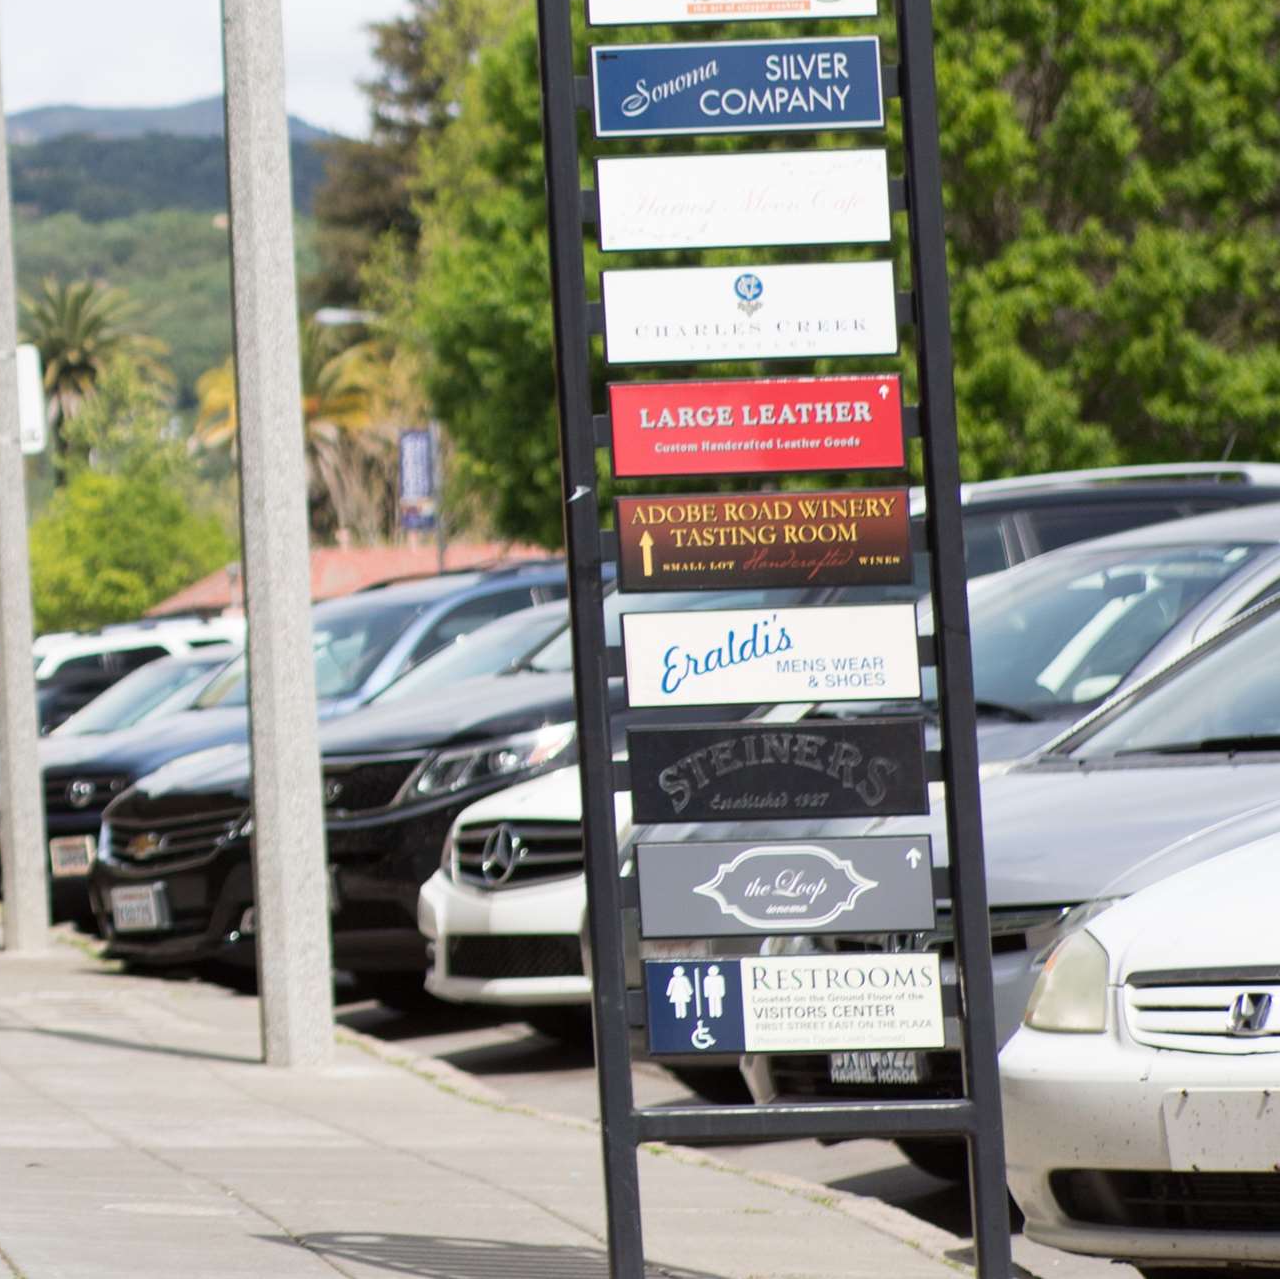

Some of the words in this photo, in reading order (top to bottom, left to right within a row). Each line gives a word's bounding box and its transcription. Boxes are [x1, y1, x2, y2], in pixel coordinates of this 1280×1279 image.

[765, 52, 849, 82] SILVER
[621, 59, 719, 118] Sonoma
[699, 84, 851, 116] COMPANY
[634, 322, 762, 338] CHARLES
[775, 318, 868, 335] CREEK
[640, 406, 735, 430] LARGE
[741, 402, 873, 427] LEATHER
[654, 442, 698, 454] Custom
[701, 438, 773, 452] Handcrafted
[776, 437, 821, 450] Leather
[824, 436, 861, 449] Goods
[631, 503, 719, 525] ADOBE
[724, 500, 792, 522] ROAD
[798, 497, 898, 520] WINERY
[669, 525, 777, 548] TASTING
[784, 522, 859, 545] ROOM
[662, 561, 706, 572] SMALL
[709, 559, 736, 571] LOT
[743, 546, 855, 581] Handcrafted
[858, 554, 901, 567] WINES
[660, 613, 794, 695] Eraldi's
[776, 658, 826, 674] MENS
[831, 656, 885, 672] WEAR
[808, 674, 819, 689] &
[824, 672, 887, 688] SHOES
[658, 731, 899, 815] STEINERS
[744, 877, 771, 898] the
[772, 868, 828, 904] Loop
[752, 965, 934, 993] RESTROOMS
[752, 994, 791, 1004] Located
[809, 993, 825, 1002] the
[827, 993, 865, 1003] Ground
[868, 992, 892, 1002] Floor
[895, 991, 906, 1001] of
[908, 991, 924, 1001] the
[753, 1005, 828, 1020] VISITORS
[832, 1004, 896, 1018] CENTER
[755, 1022, 784, 1031] FIRST
[787, 1021, 825, 1031] STREET
[828, 1020, 854, 1030] EAST
[858, 1020, 874, 1029] ON
[877, 1019, 895, 1029] THE
[899, 1018, 933, 1028] PLAZA
